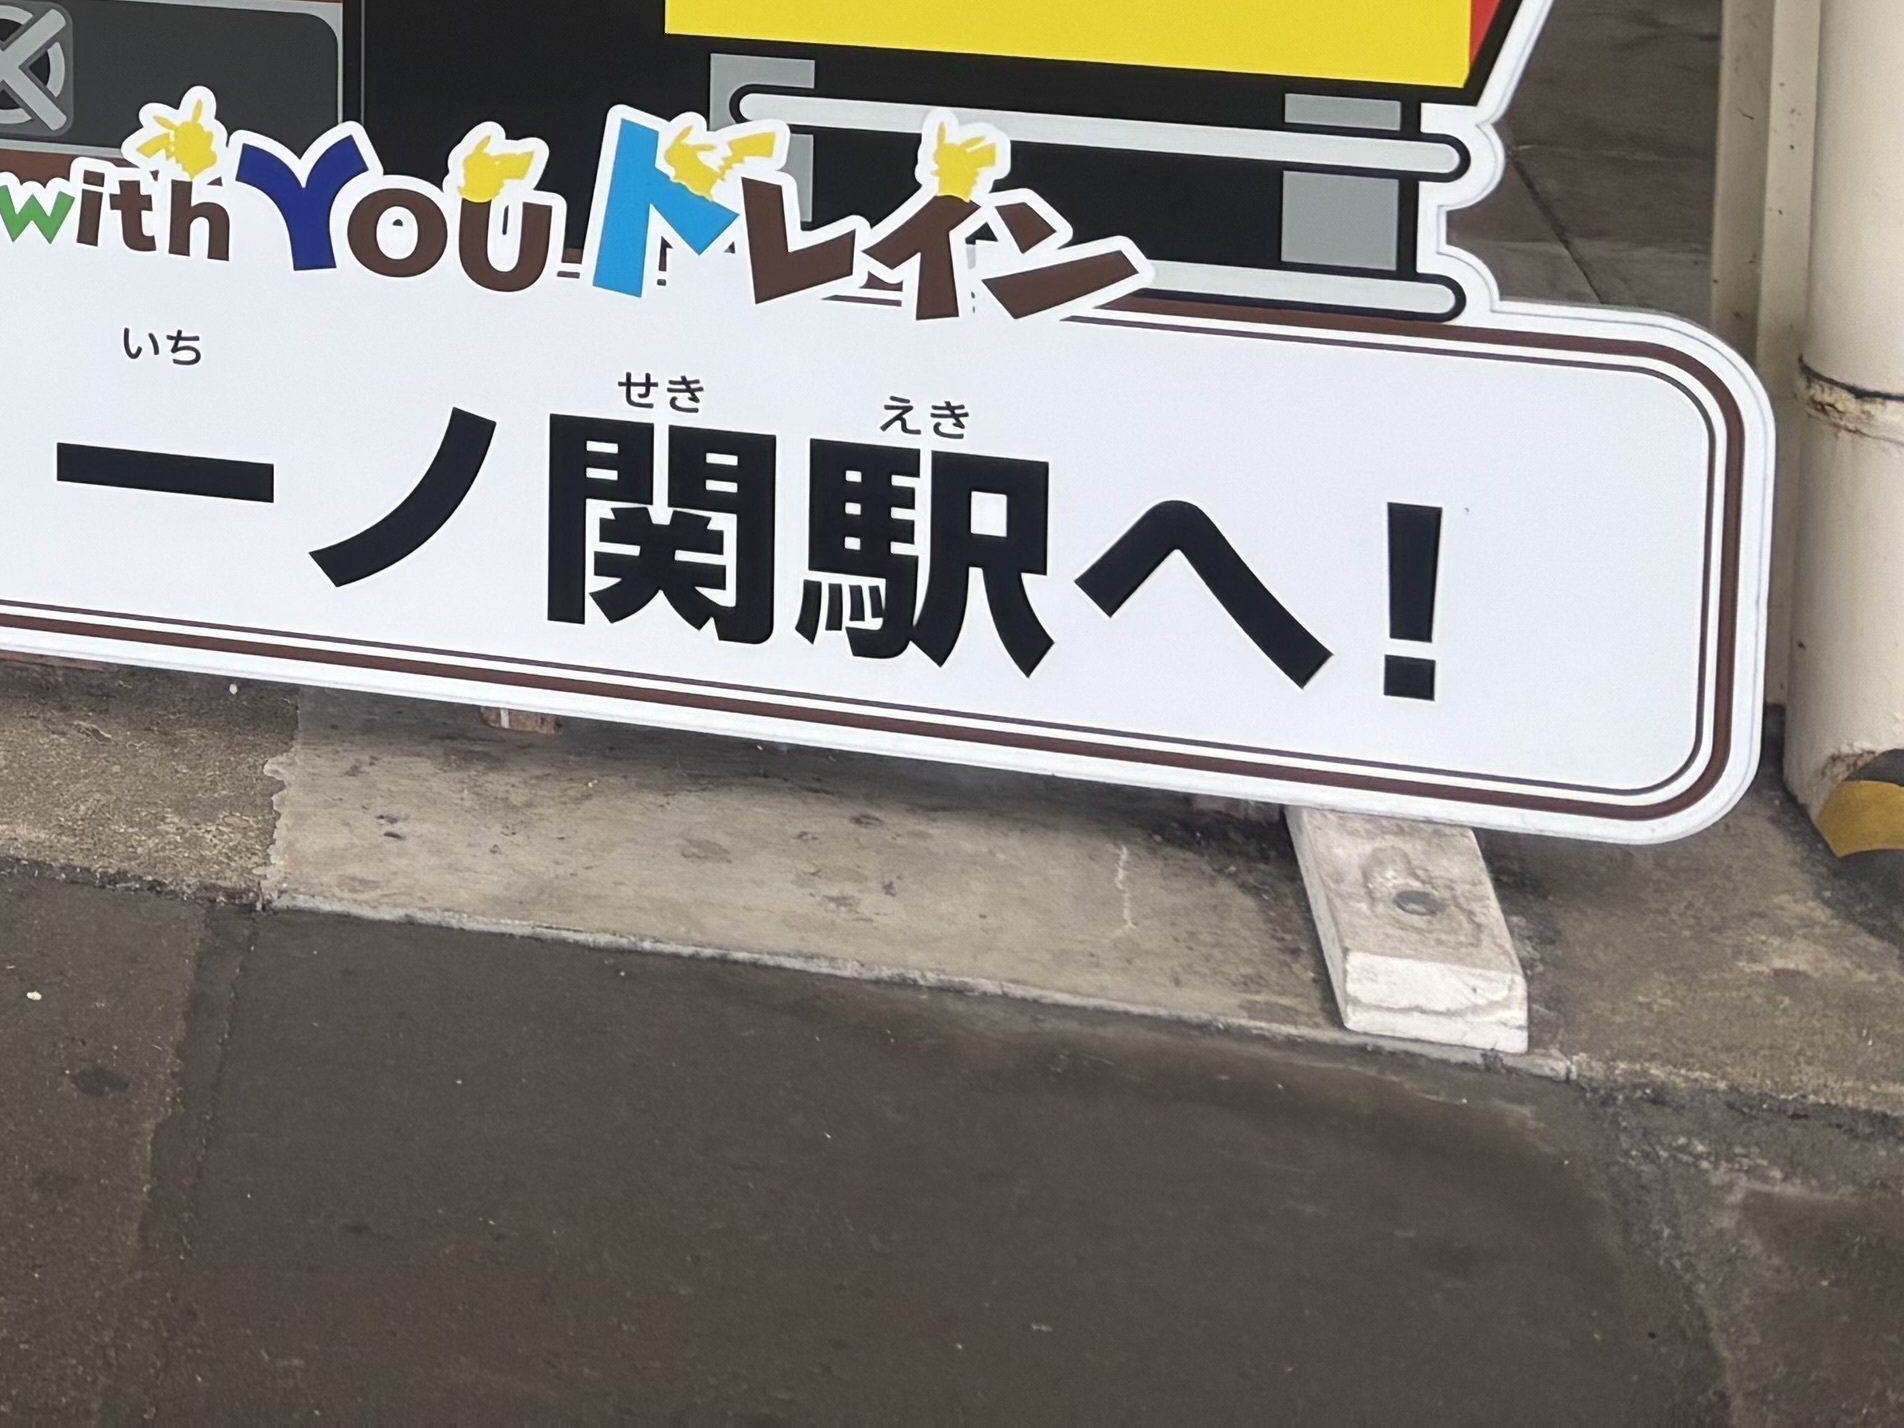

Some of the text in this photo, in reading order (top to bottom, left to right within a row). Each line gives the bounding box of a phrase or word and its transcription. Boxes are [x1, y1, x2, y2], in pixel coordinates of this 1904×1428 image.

[122, 326, 203, 368] いち
[616, 370, 706, 414] せき
[880, 393, 971, 440] えき
